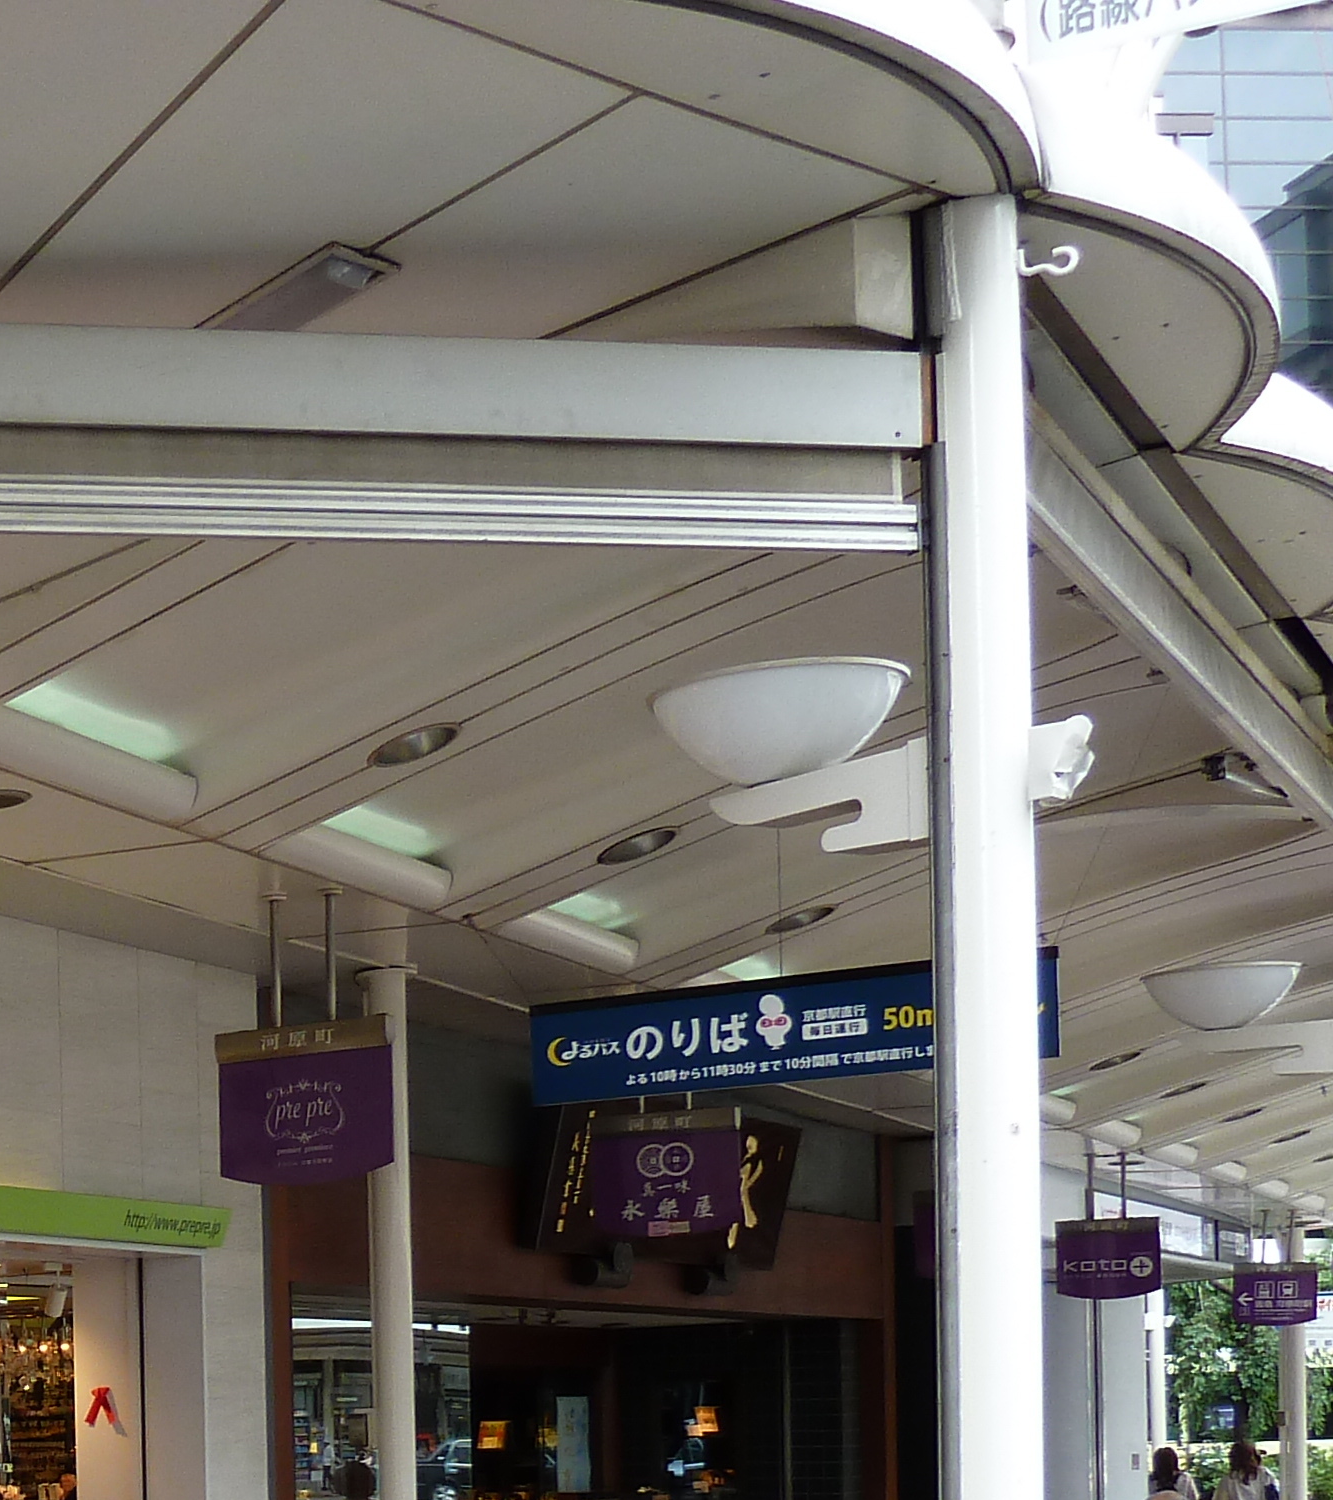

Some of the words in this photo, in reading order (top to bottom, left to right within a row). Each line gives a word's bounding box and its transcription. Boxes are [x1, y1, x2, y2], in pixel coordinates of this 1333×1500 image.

[260, 1027, 335, 1052] 河原町
[561, 1040, 621, 1061] よるバス
[625, 1013, 750, 1061] のりば
[274, 1101, 302, 1131] pre
[305, 1097, 333, 1128] pre
